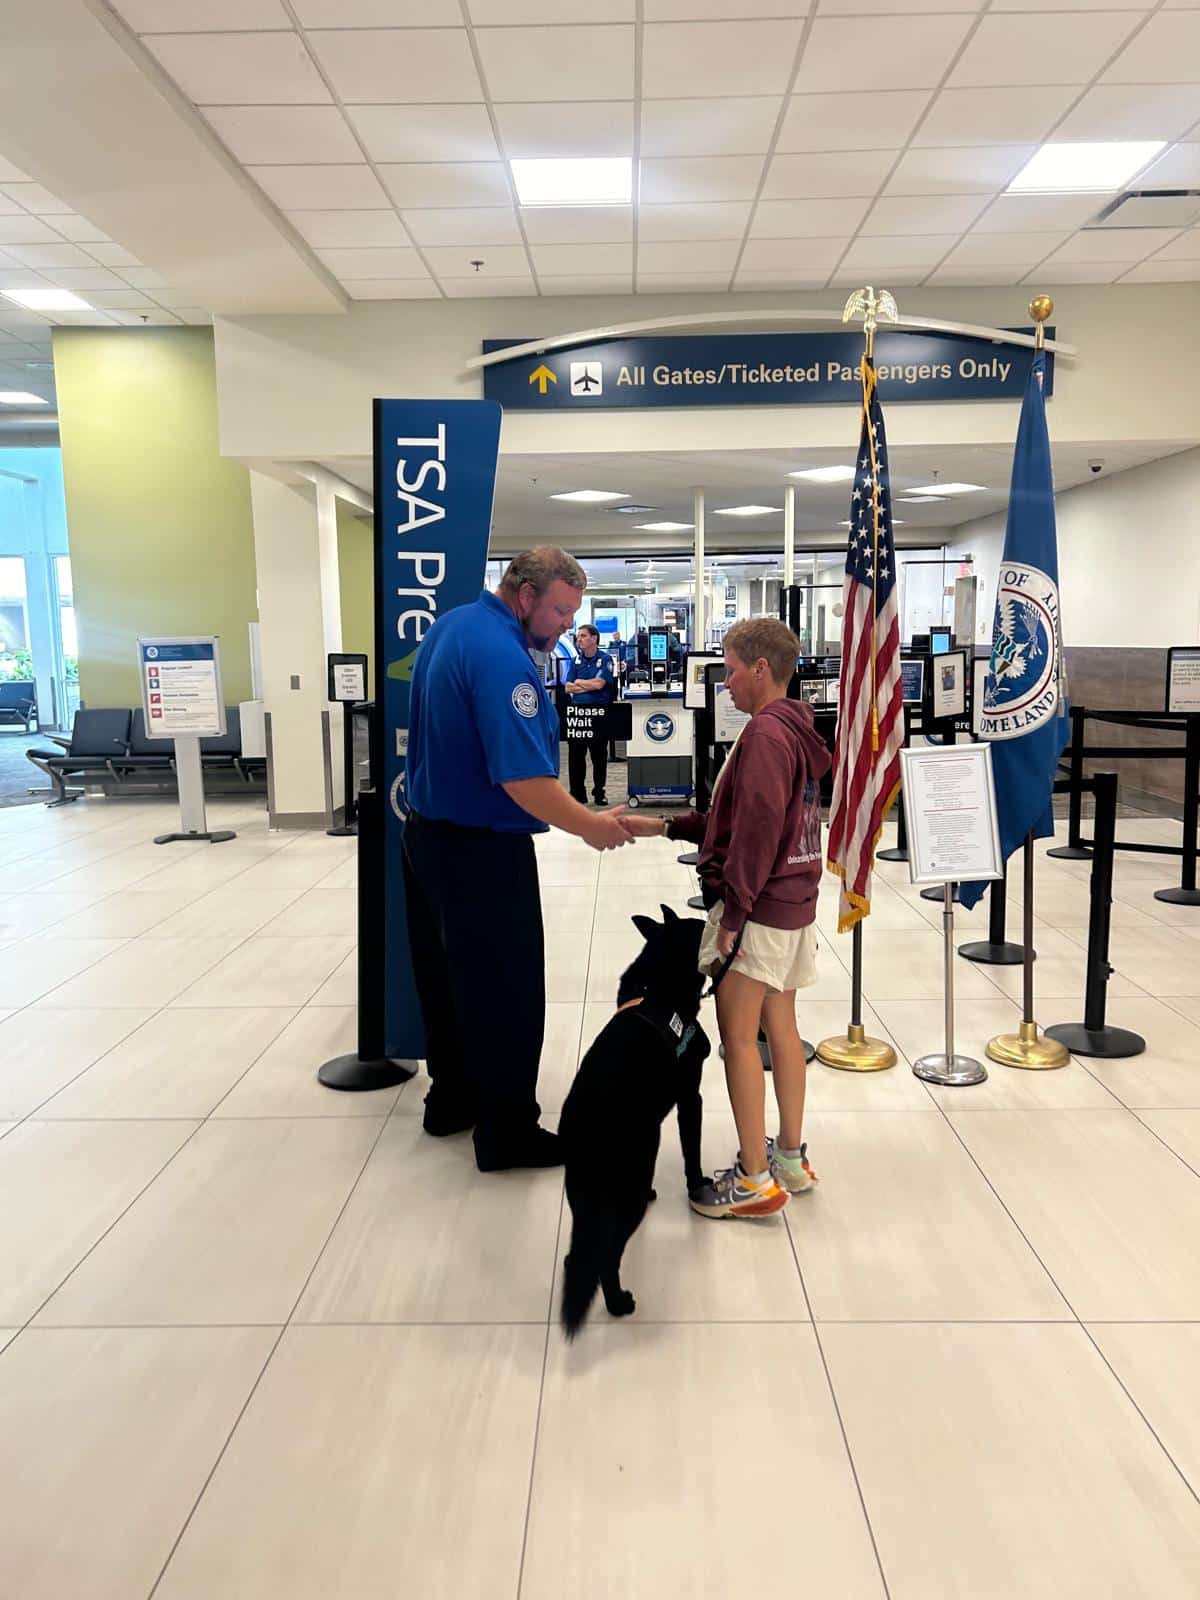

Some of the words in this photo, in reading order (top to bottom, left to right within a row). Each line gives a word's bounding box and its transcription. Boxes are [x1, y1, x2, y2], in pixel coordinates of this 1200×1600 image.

[616, 366, 645, 386] All
[652, 363, 820, 386] Gates/Ticketed
[827, 361, 952, 384] Pasengers
[958, 358, 1011, 382] Only
[396, 423, 446, 534] TSA
[1003, 570, 1030, 587] OF
[396, 551, 446, 642] Pre
[566, 706, 605, 716] Please
[980, 690, 1055, 732] OMELAND
[566, 717, 593, 727] Wait
[954, 721, 970, 730] ere
[567, 728, 594, 738] Here
